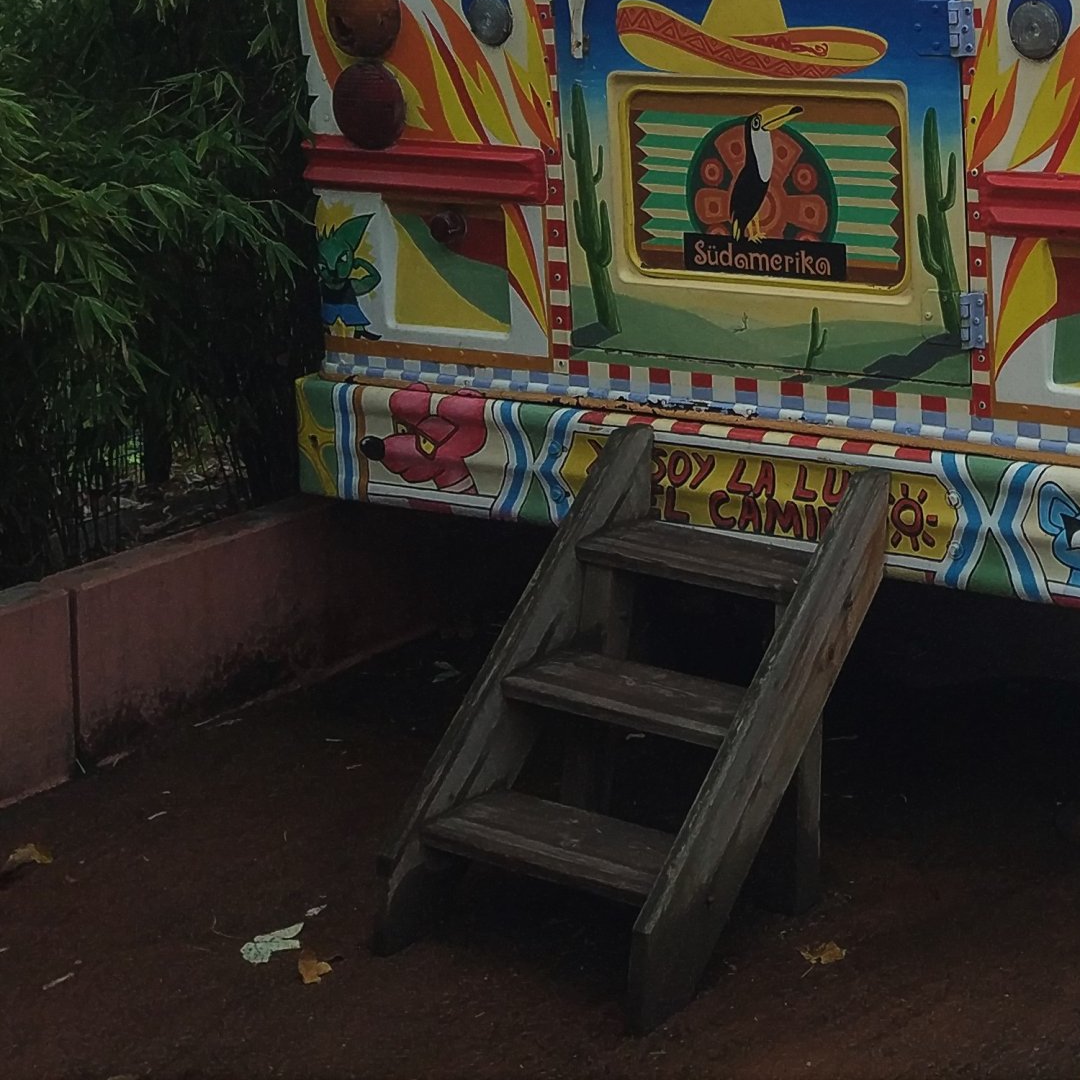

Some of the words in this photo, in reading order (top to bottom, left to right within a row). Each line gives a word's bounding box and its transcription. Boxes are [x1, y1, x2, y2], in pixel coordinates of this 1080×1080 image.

[693, 239, 831, 276] Südamerika
[651, 447, 716, 490] SOY
[726, 457, 776, 499] LA
[792, 464, 852, 507] LU
